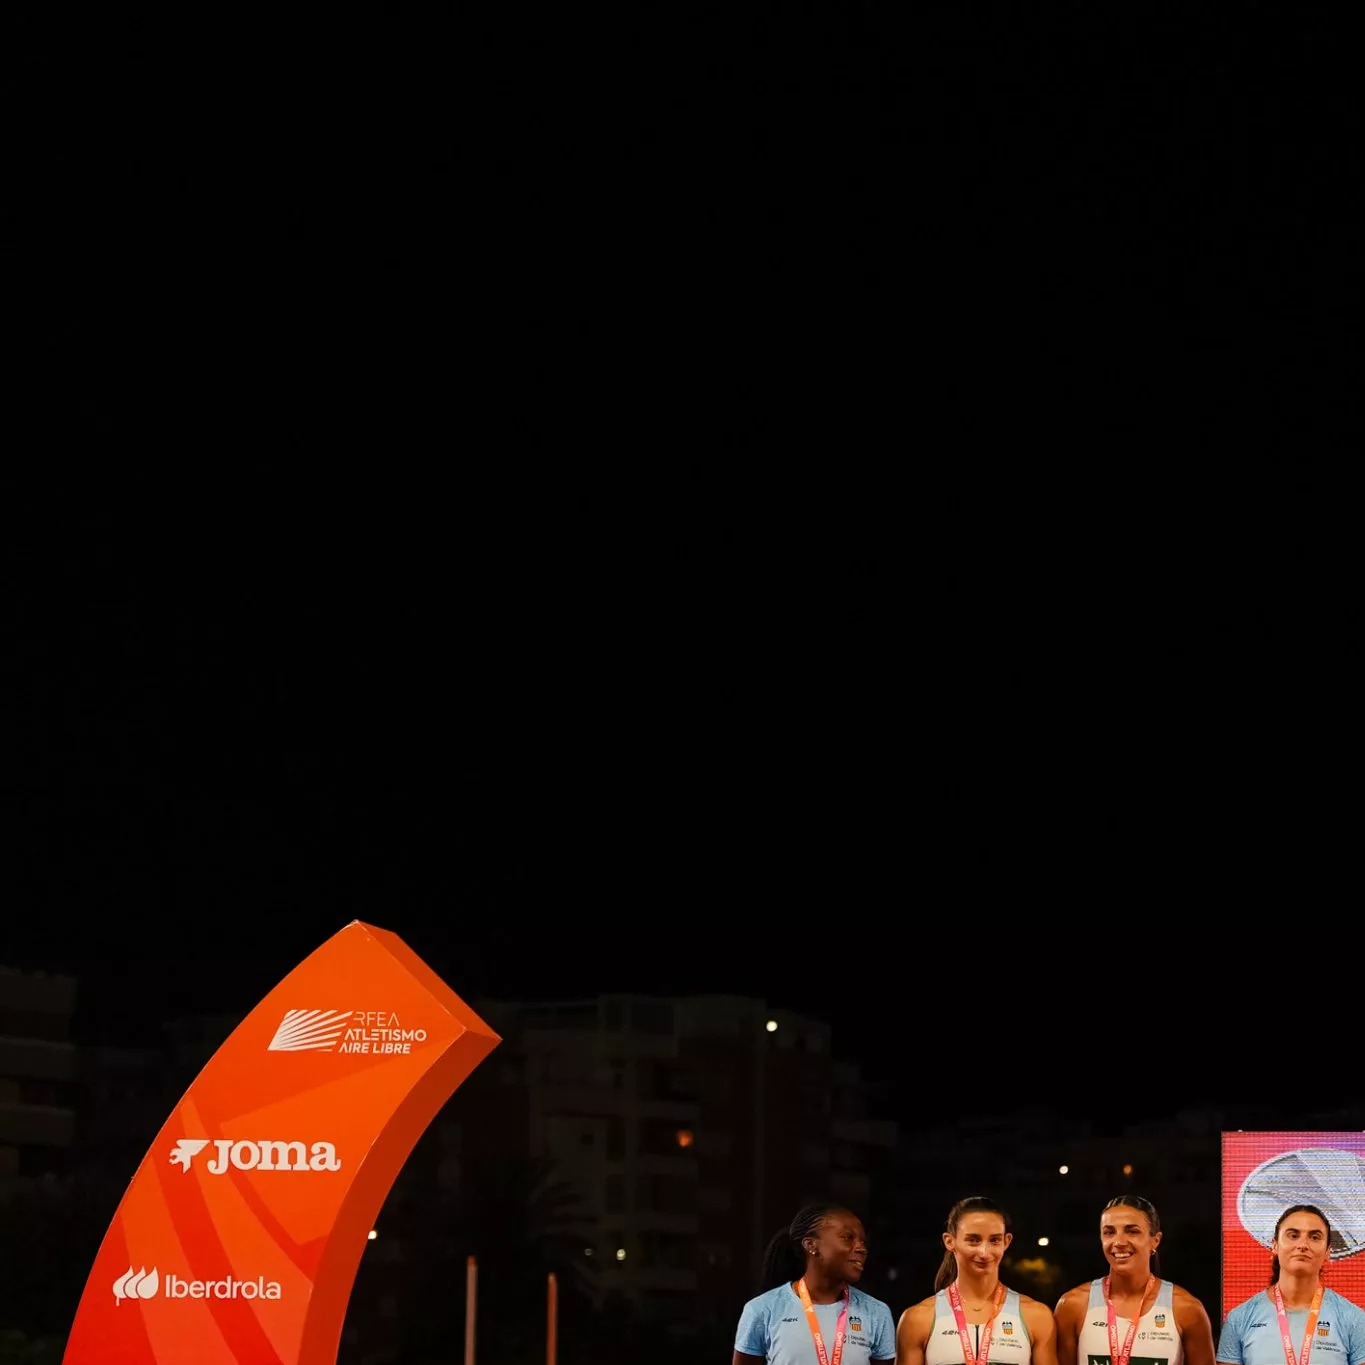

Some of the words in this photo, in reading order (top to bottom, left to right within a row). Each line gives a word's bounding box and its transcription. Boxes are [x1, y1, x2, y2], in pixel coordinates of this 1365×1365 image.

[344, 1028, 427, 1041] ATLETISMO
[339, 1042, 370, 1053] AIRE
[372, 1043, 411, 1054] LIBRE
[165, 1275, 282, 1300] Iberdrola
